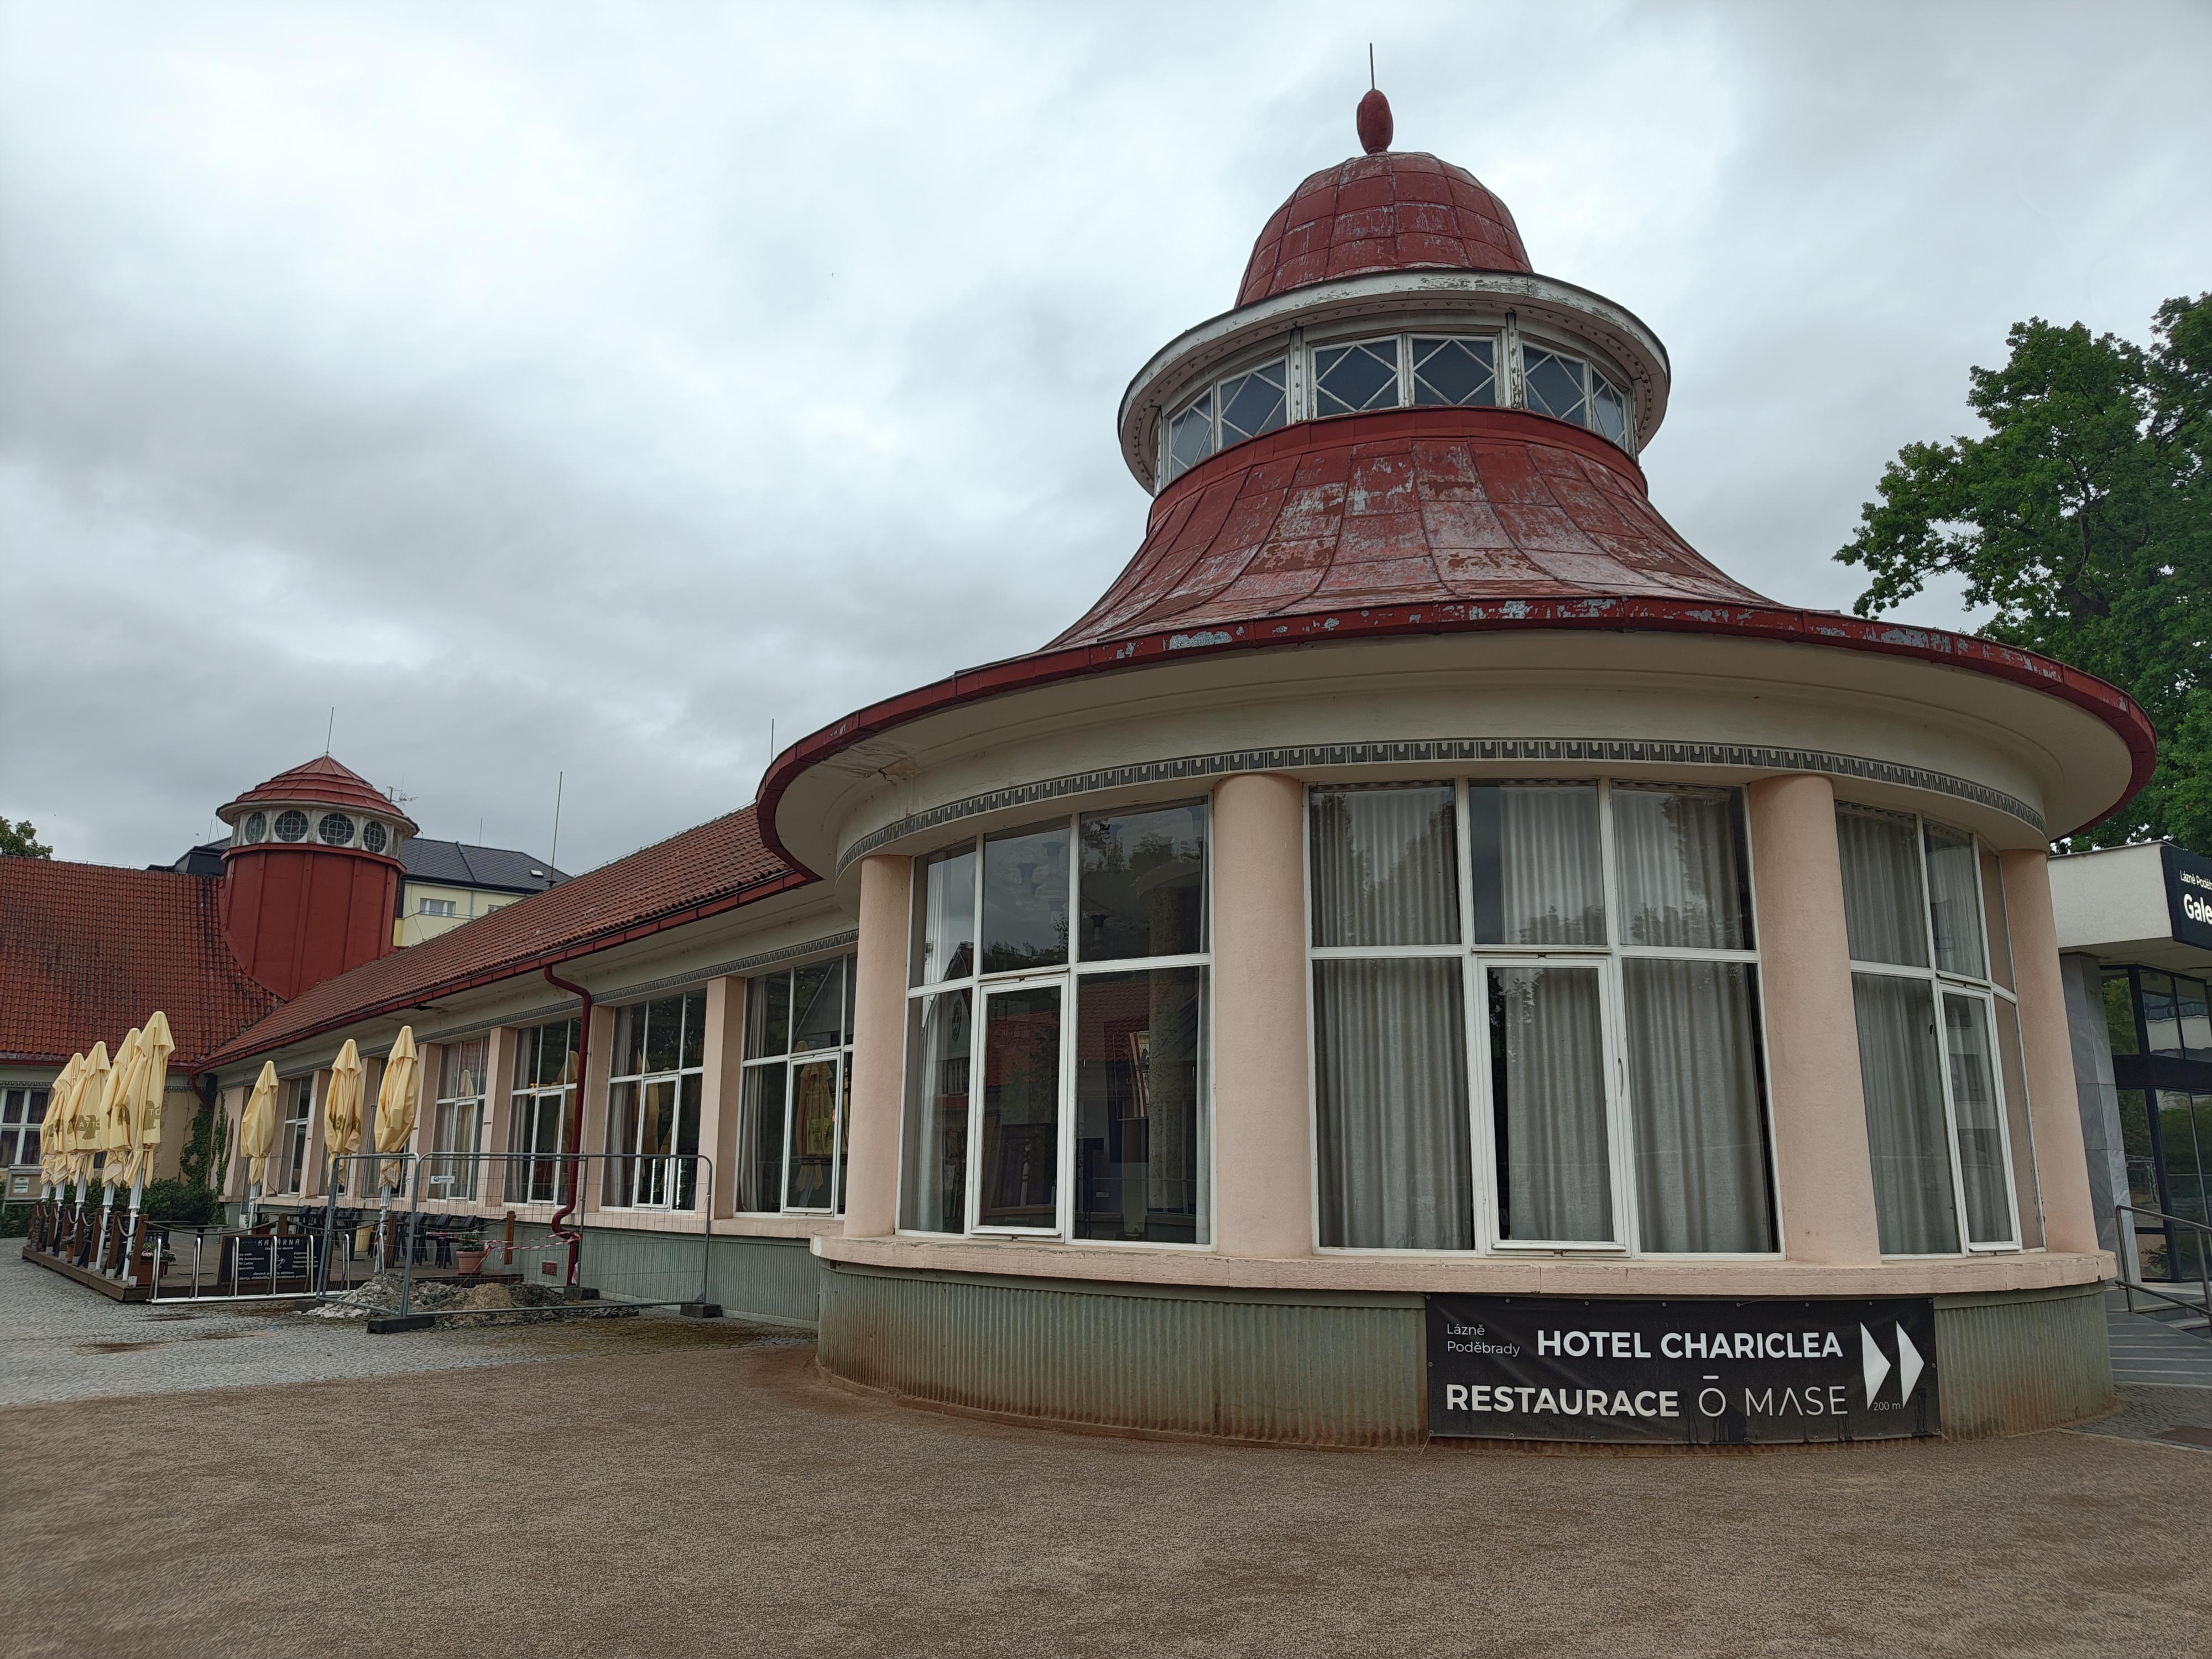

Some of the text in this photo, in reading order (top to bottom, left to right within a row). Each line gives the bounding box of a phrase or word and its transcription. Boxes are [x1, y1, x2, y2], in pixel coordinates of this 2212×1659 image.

[2180, 869, 2195, 885] Lázně
[258, 1238, 300, 1246] KAÁRNA
[1447, 1323, 1485, 1335] Lázně
[1447, 1340, 1520, 1357] Poděbrady
[1537, 1330, 1843, 1359] HOTEL CHARICLEA
[1447, 1384, 1679, 1417] RESTAURACE
[1873, 1401, 1890, 1411] 200
